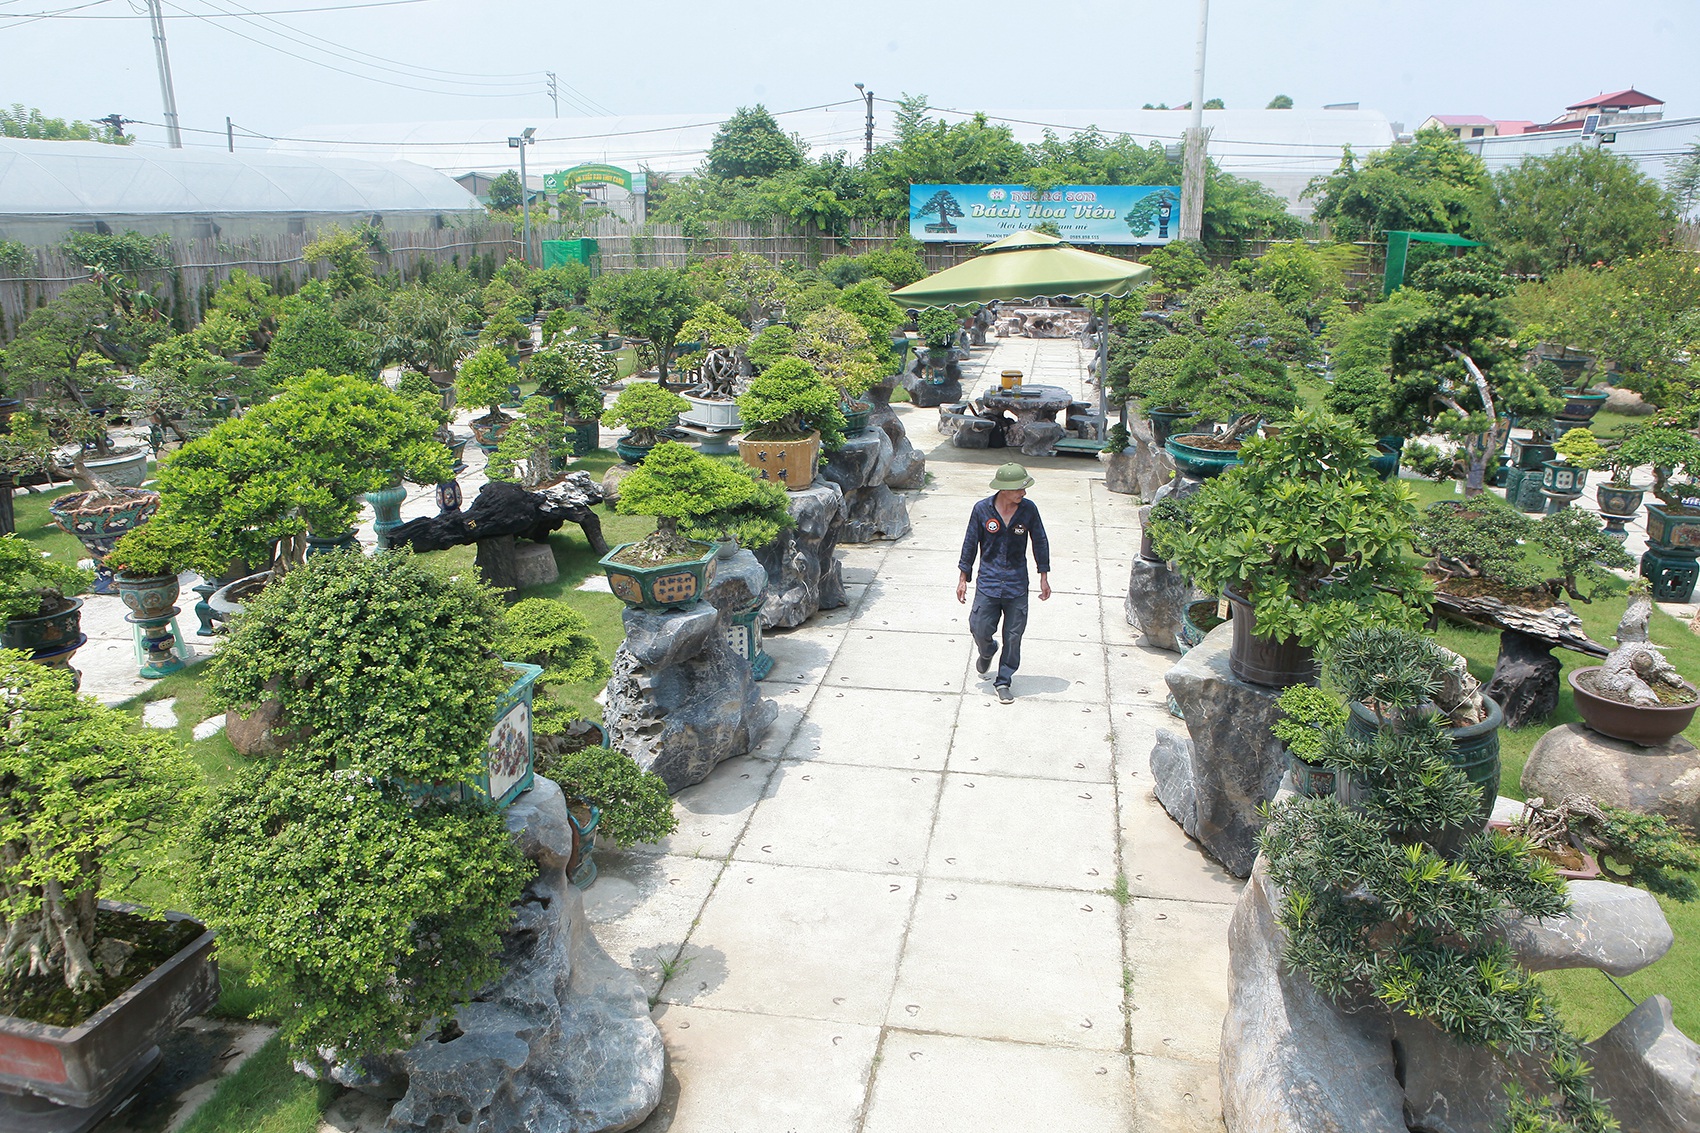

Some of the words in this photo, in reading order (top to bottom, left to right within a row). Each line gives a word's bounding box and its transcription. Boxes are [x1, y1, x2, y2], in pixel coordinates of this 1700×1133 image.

[970, 203, 1021, 218] Bách
[1026, 204, 1067, 219] Hoa
[1071, 204, 1116, 219] Viên
